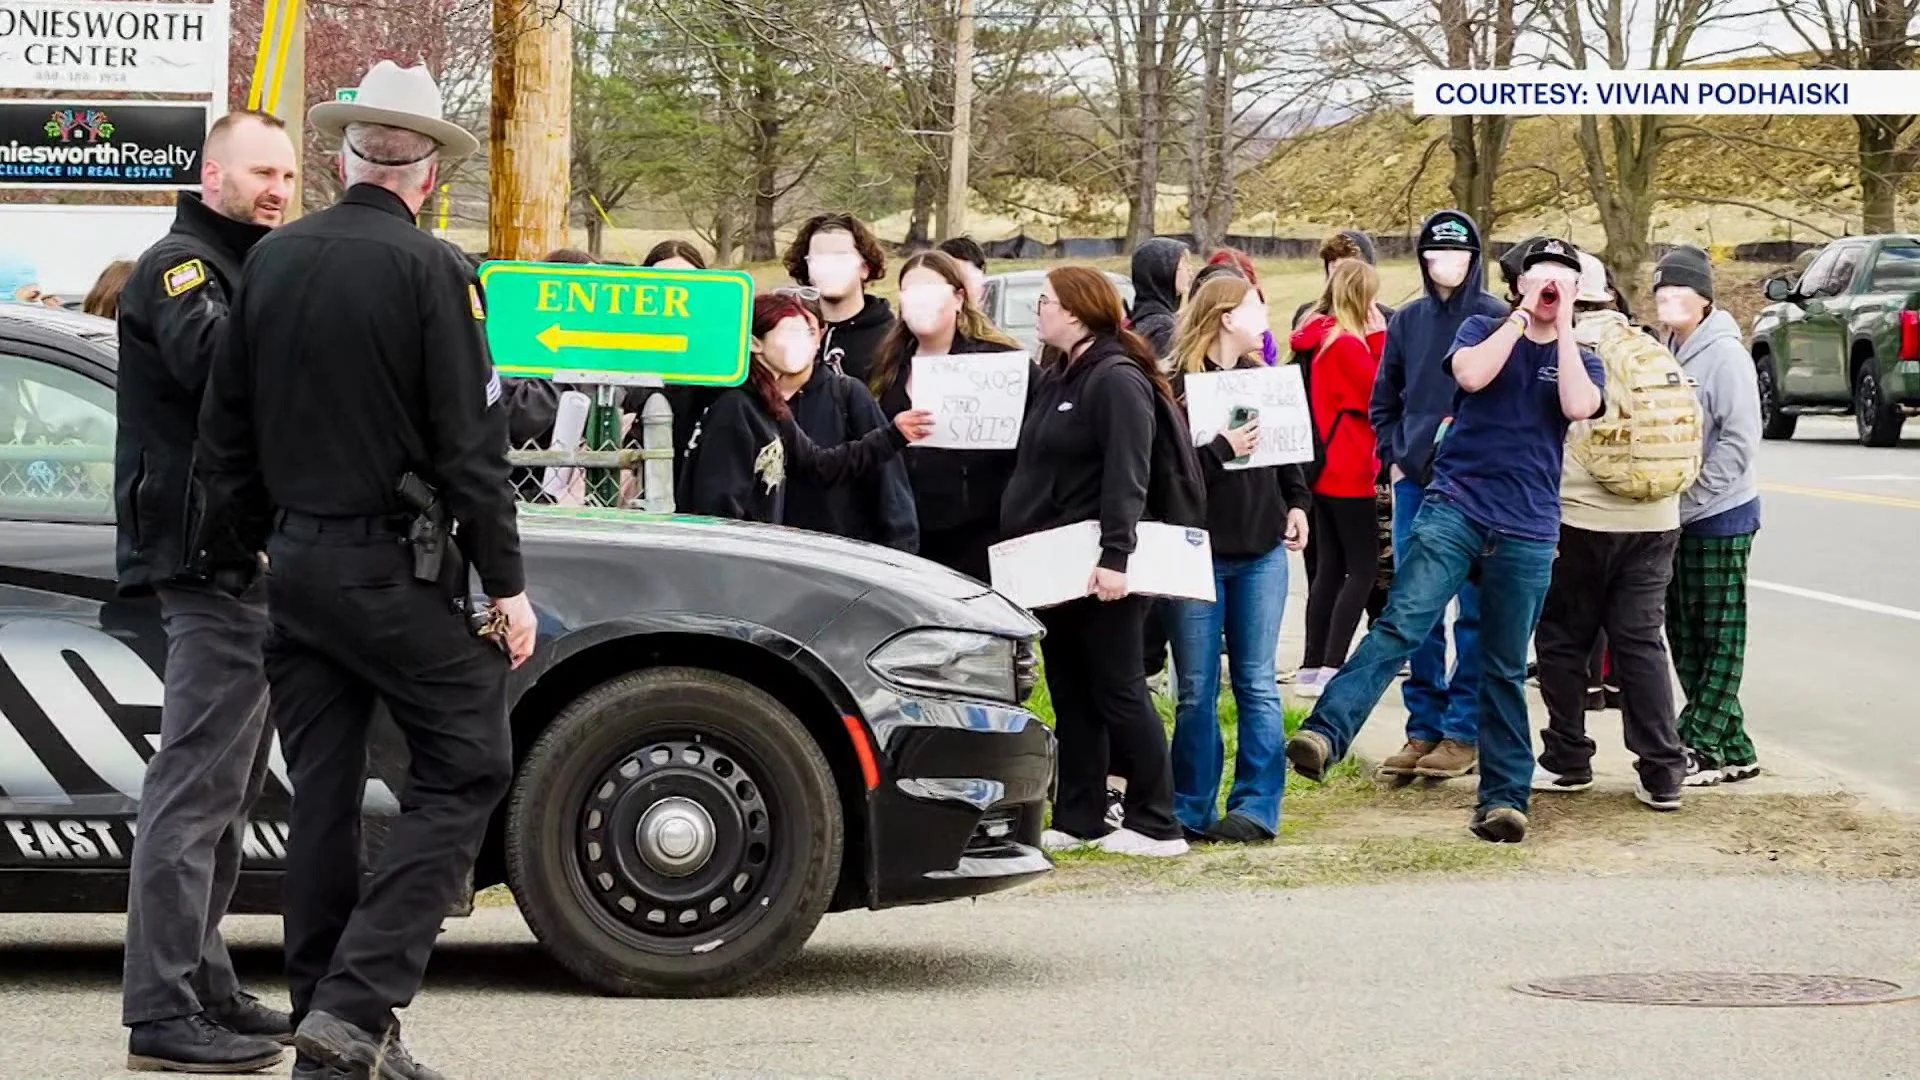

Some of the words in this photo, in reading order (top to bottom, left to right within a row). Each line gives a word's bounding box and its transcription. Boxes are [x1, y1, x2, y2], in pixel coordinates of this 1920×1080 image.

[24, 43, 137, 68] CENTER
[67, 166, 83, 176] IN
[87, 166, 121, 177] REAL
[125, 166, 173, 178] ESTATE
[535, 280, 691, 318] ENTER
[4, 820, 124, 859] EAST
